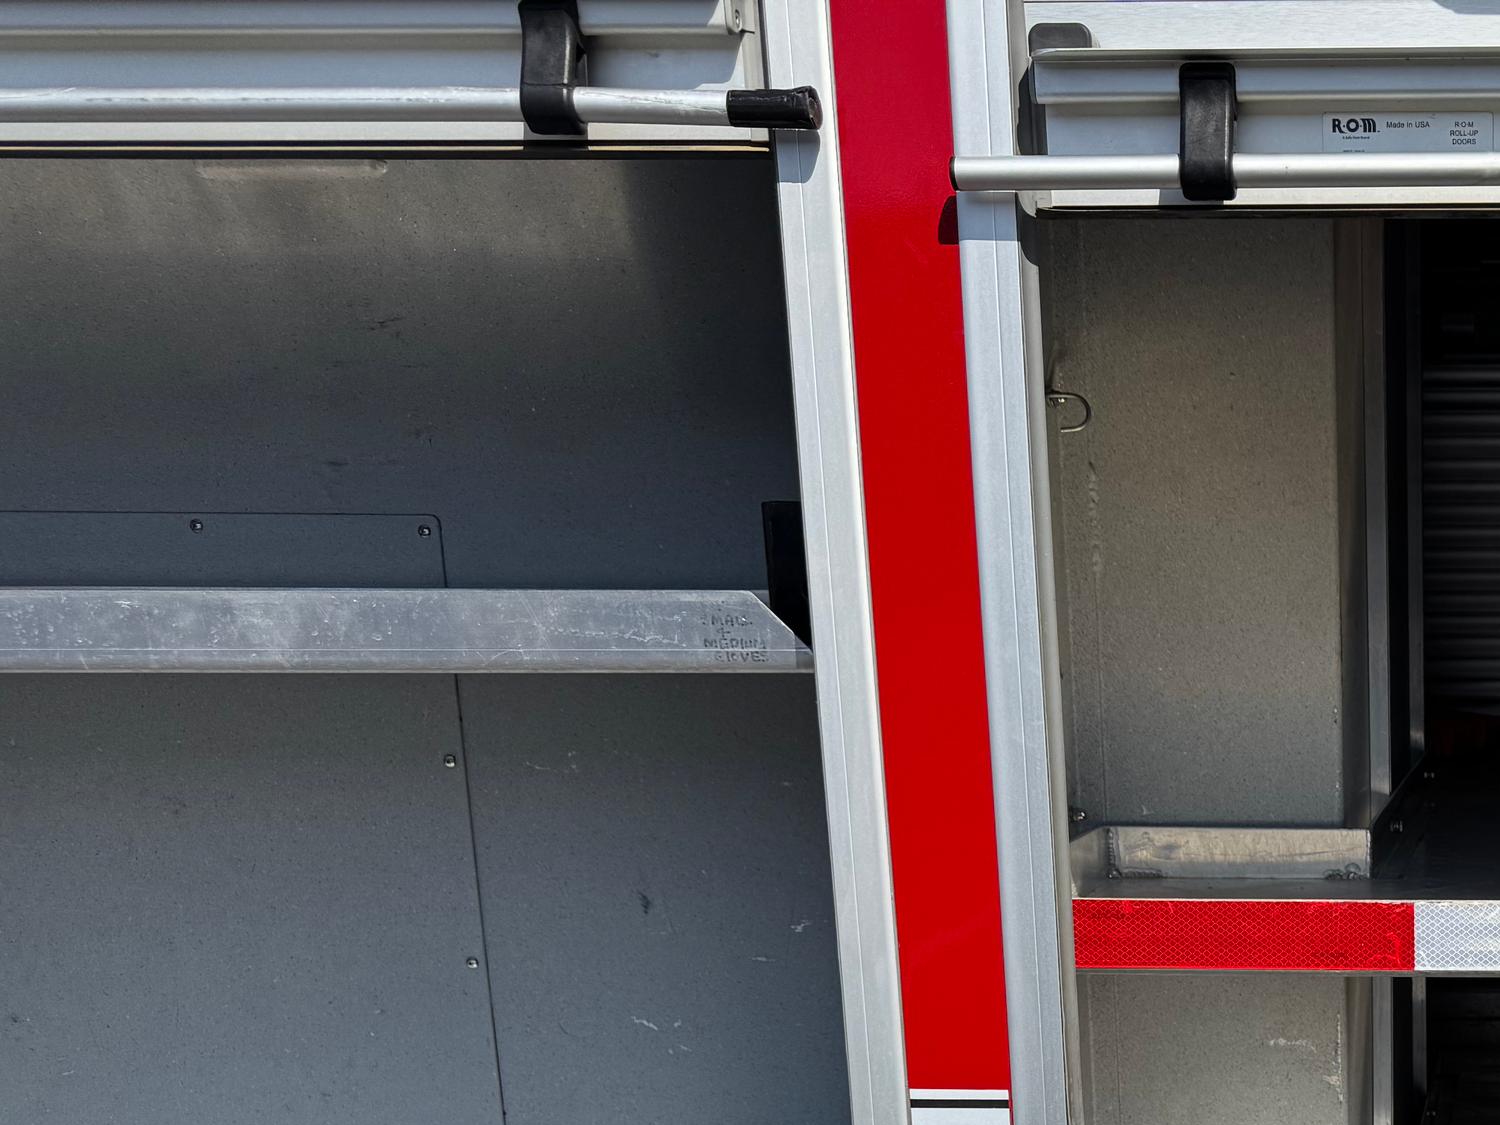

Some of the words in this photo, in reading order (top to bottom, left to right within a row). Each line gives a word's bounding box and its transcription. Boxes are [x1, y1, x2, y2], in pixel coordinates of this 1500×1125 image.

[1386, 121, 1405, 129] Made
[1415, 121, 1430, 129] USA
[1449, 129, 1479, 137] ROLL-UP
